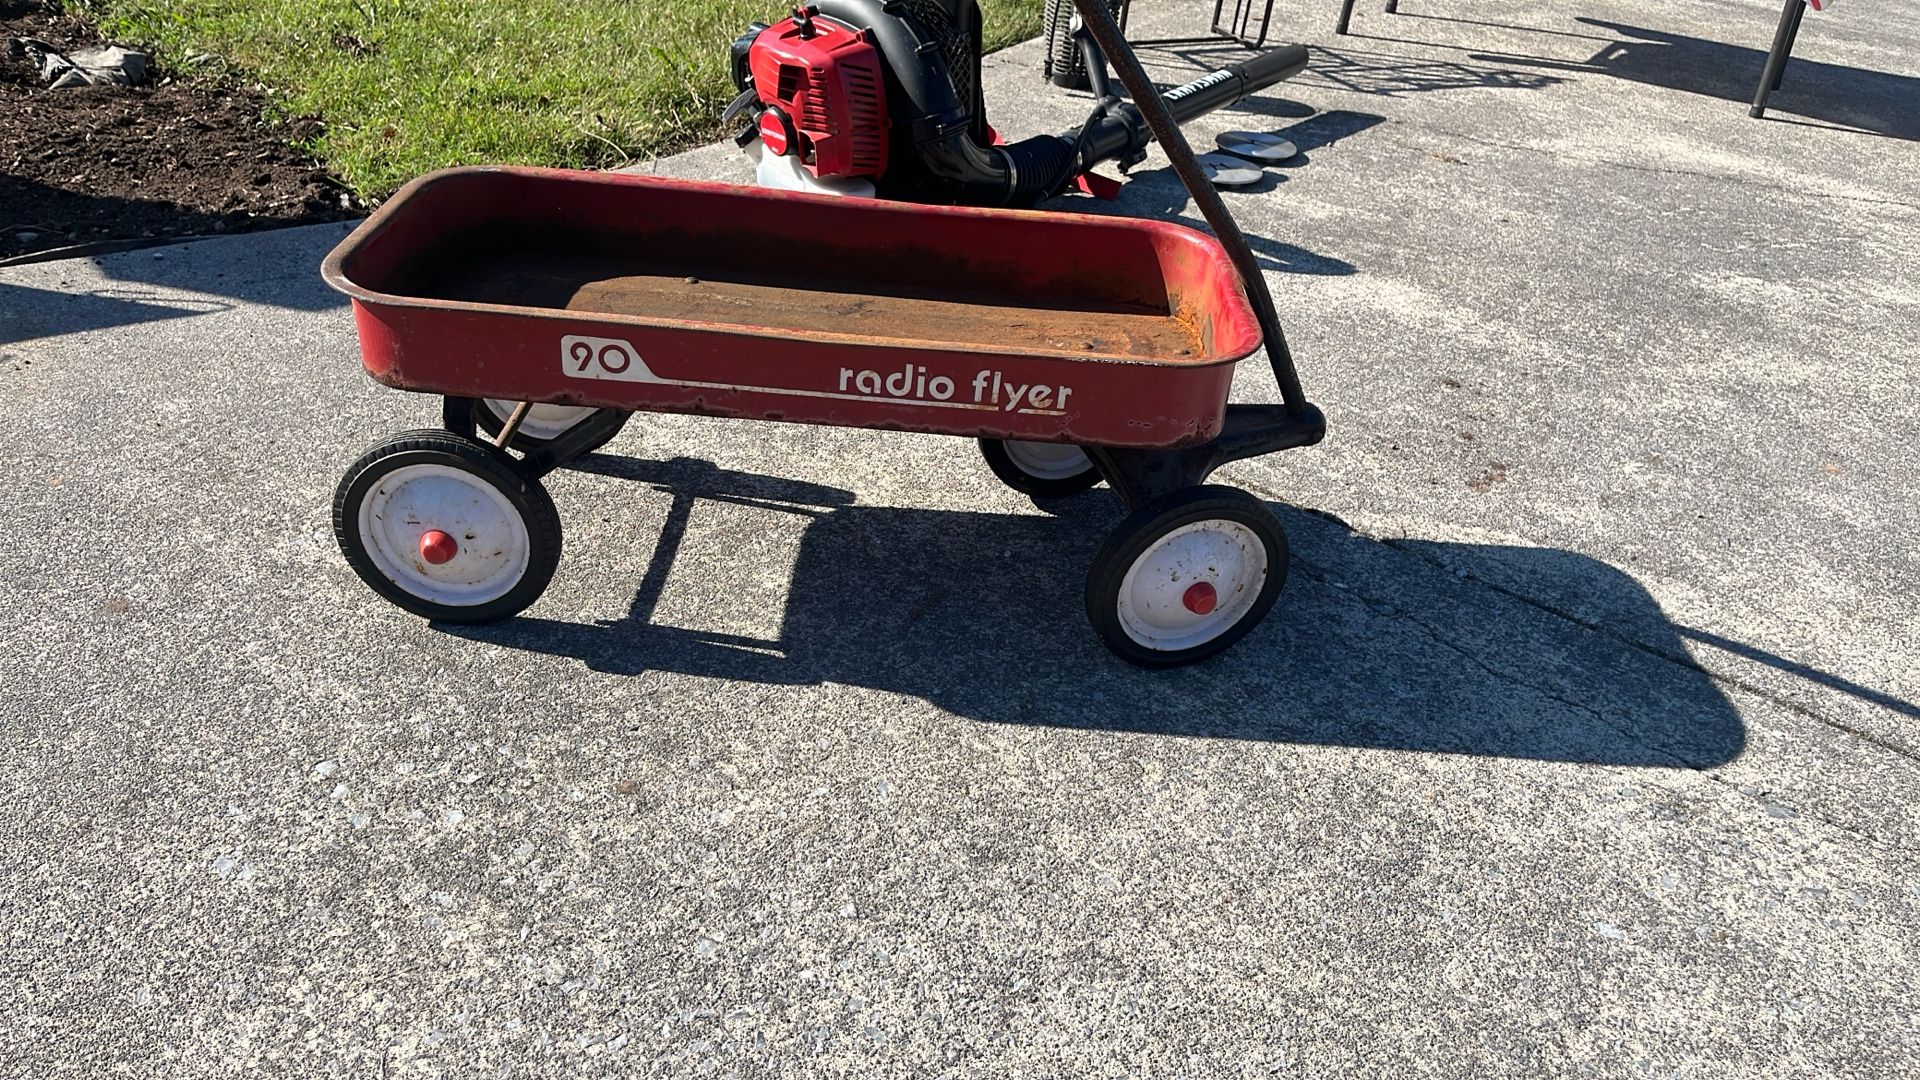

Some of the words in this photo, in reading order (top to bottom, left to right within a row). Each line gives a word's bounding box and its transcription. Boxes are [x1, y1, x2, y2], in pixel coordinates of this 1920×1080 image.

[1162, 69, 1233, 100] CRAFTSMAN
[570, 342, 630, 373] 90
[838, 364, 955, 400] radio
[972, 369, 1073, 412] flyer
